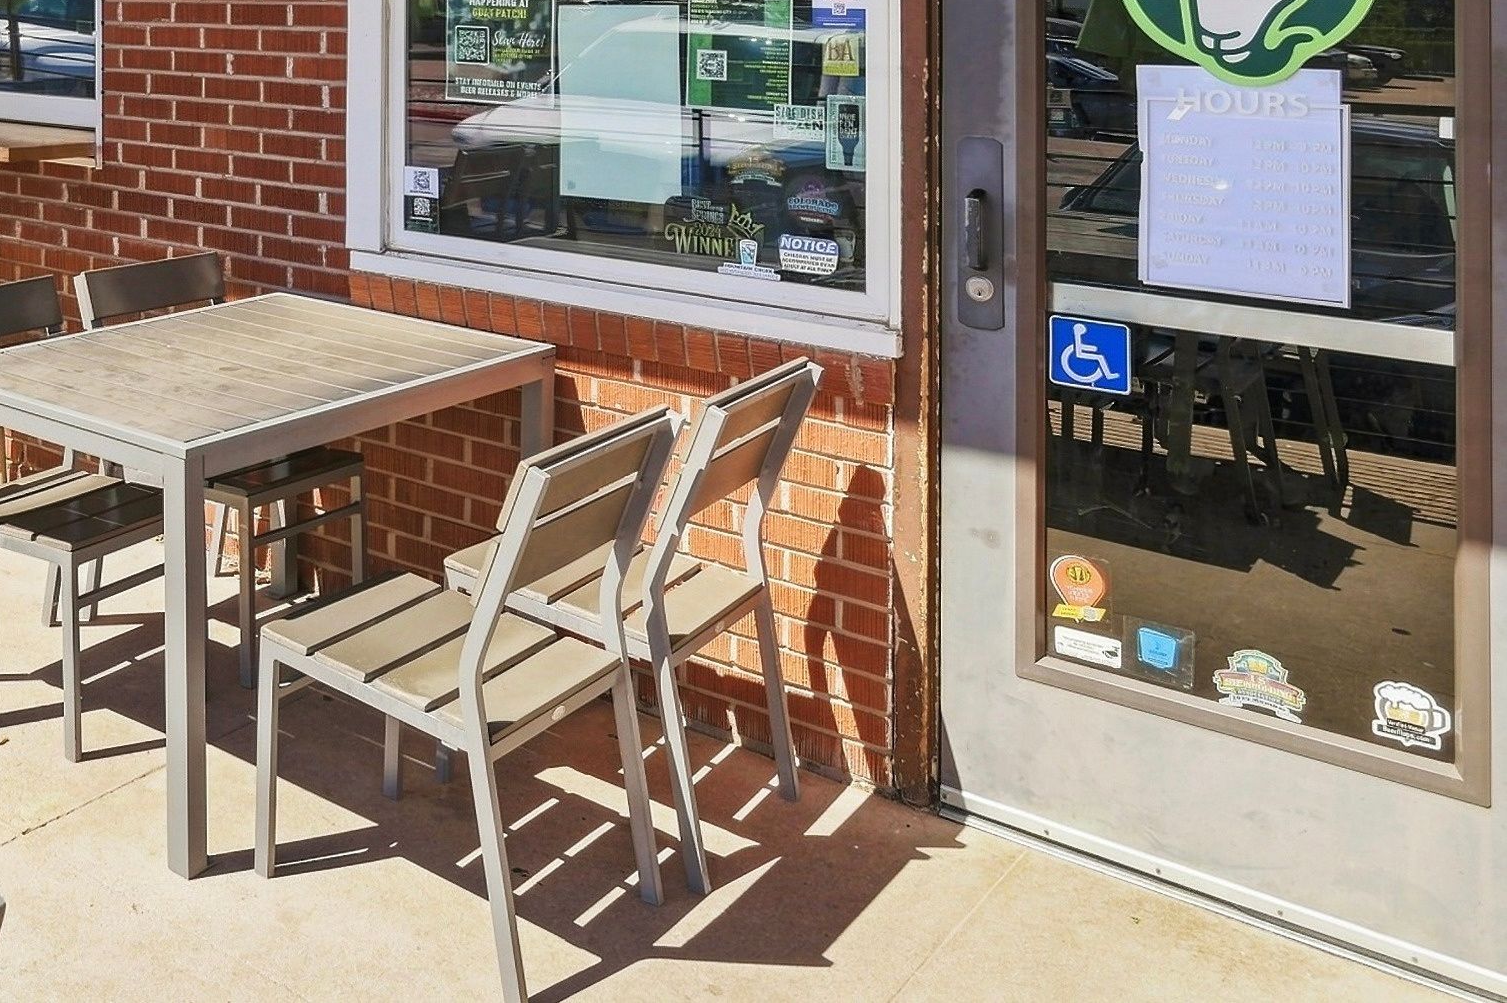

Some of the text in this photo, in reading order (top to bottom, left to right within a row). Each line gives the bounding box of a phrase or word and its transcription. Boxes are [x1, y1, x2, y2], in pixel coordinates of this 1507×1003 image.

[472, 7, 527, 19] GOAT PATCH!
[518, 32, 546, 48] Here!
[455, 77, 471, 86] STAY
[472, 78, 505, 87] INFORMED
[506, 80, 516, 88] ON
[460, 86, 477, 94] BEER
[477, 87, 510, 97] RELEASES
[1176, 87, 1310, 118] HOURS
[775, 105, 824, 120] SIDE DISH
[788, 197, 839, 210] COLORADO
[695, 222, 721, 238] 2024
[780, 236, 837, 254] NOTICE
[782, 257, 819, 266] ACCOMPANIED
